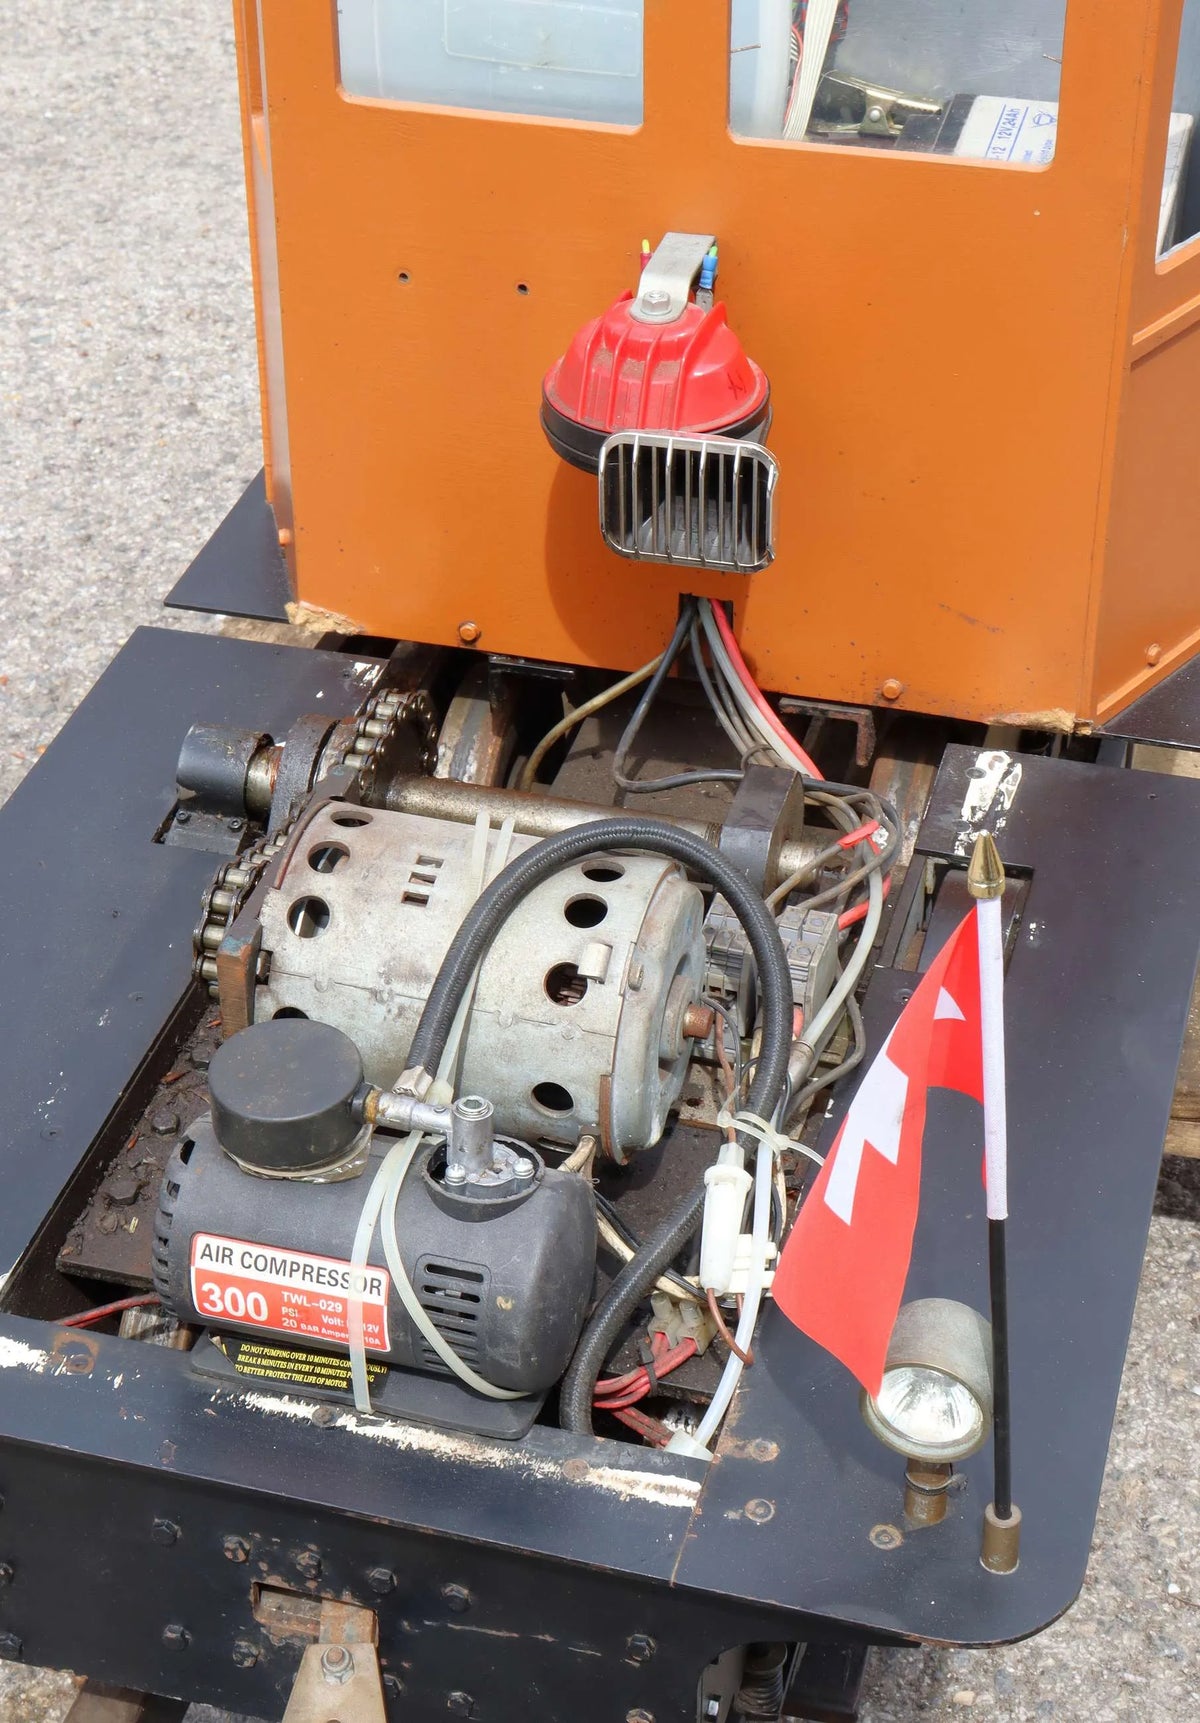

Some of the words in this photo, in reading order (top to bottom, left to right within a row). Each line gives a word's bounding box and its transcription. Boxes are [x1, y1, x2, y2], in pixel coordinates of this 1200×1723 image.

[200, 1243, 234, 1266] AIR
[241, 1251, 382, 1296] COMPRESSOR
[201, 1282, 268, 1322] 300
[281, 1291, 343, 1313] TWL-029
[281, 1306, 298, 1318] PSI
[321, 1315, 345, 1327] Volt:
[281, 1318, 298, 1328] 20
[300, 1323, 320, 1333] BAR
[321, 1327, 349, 1339] Amper
[364, 1336, 381, 1345] 10A
[237, 1354, 256, 1365] BREAK
[261, 1358, 287, 1369] MINUTES
[294, 1363, 314, 1373] EVERY
[320, 1366, 348, 1378] MINUTES
[240, 1343, 250, 1352] DO
[250, 1345, 264, 1355] NOT
[263, 1348, 290, 1359] PUMPING
[290, 1351, 307, 1361] OVER
[313, 1355, 340, 1366] MINUTES
[235, 1364, 243, 1372] TO
[243, 1366, 265, 1377] BETTER
[265, 1369, 292, 1380] PROTECT
[292, 1373, 304, 1381] THE
[303, 1374, 317, 1382] LIFE
[316, 1377, 326, 1385] OF
